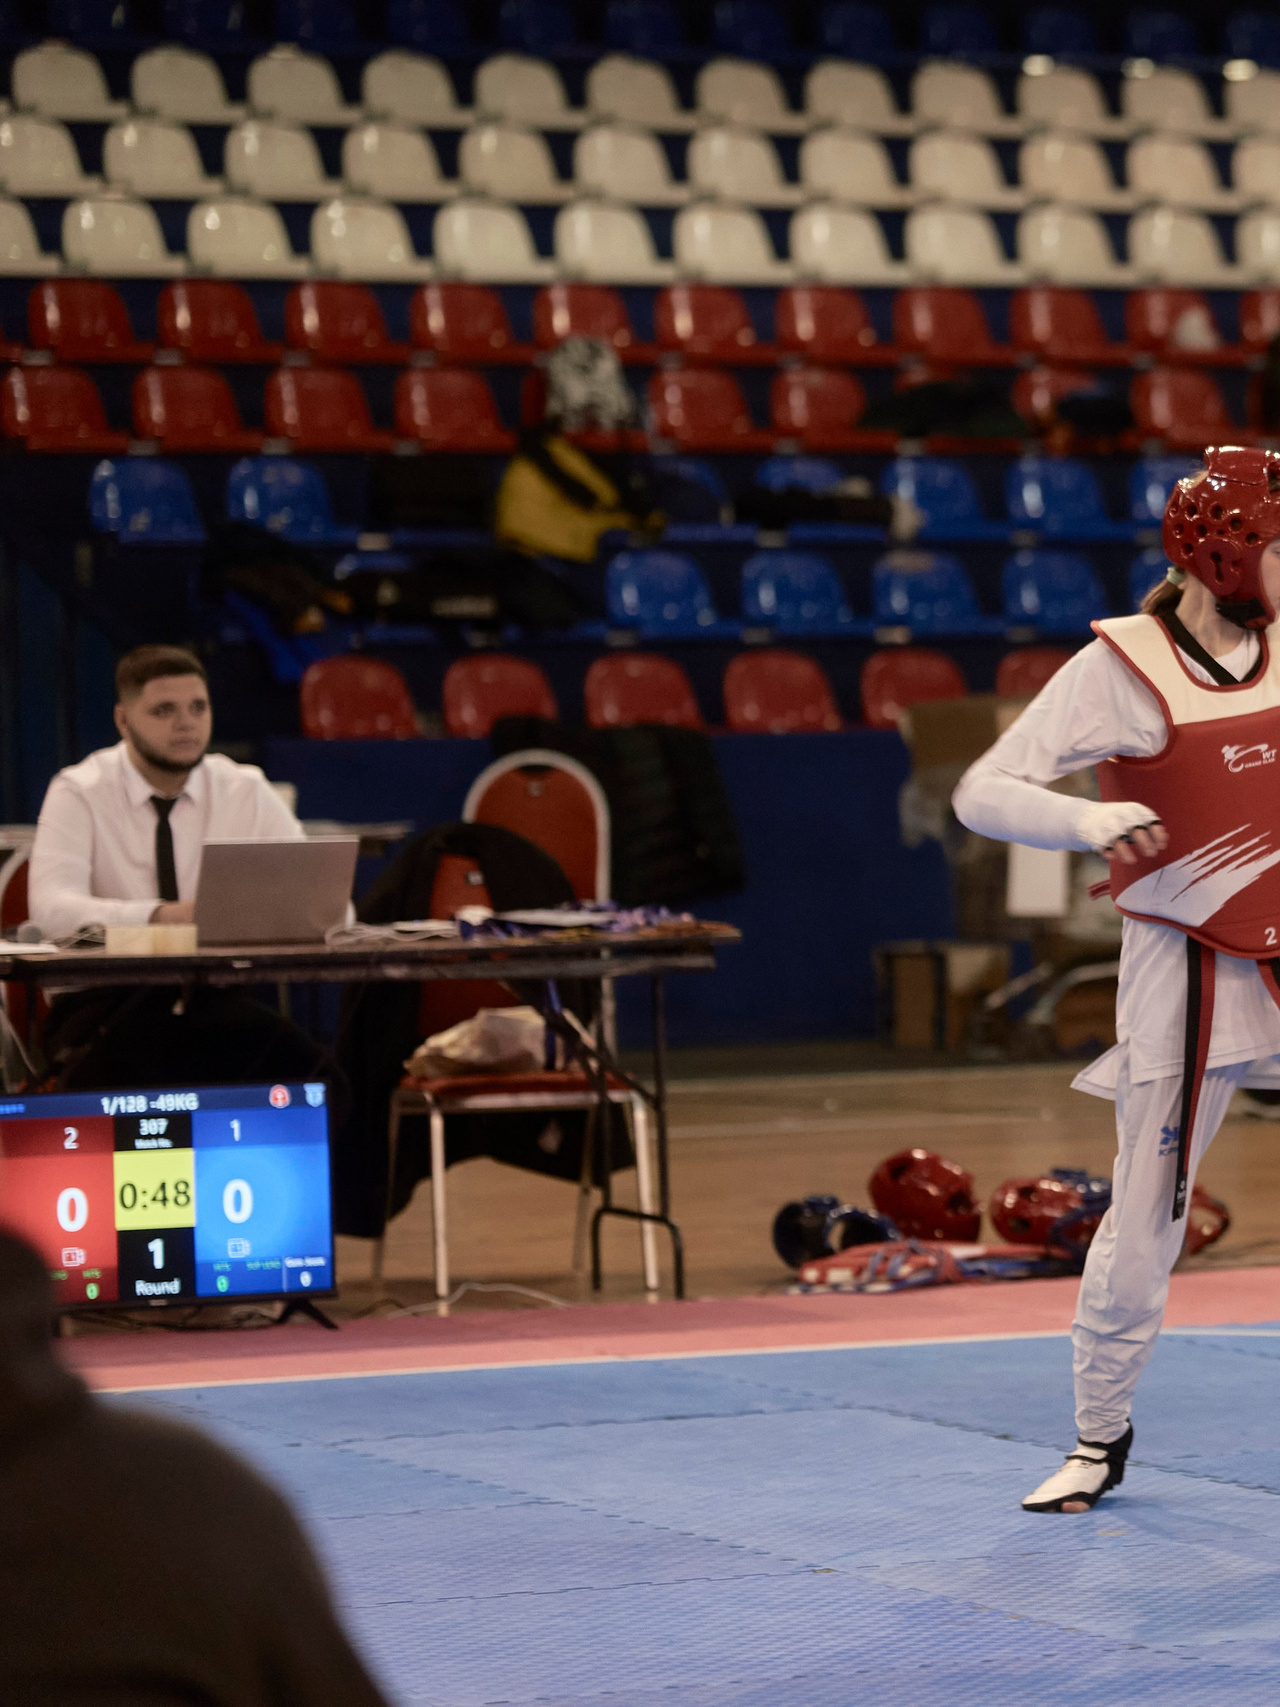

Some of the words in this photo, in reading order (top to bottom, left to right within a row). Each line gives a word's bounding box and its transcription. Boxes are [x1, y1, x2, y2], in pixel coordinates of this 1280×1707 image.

[1262, 749, 1277, 760] WT
[1264, 927, 1278, 946] 2
[101, 1095, 147, 1116] 1/128
[150, 1093, 199, 1112] -49KG
[63, 1126, 79, 1150] 2
[139, 1118, 169, 1136] 307
[230, 1119, 241, 1142] 1
[119, 1180, 191, 1210] 0:48
[222, 1179, 254, 1224] 0
[56, 1187, 89, 1233] 0
[147, 1238, 165, 1270] 1
[86, 1282, 99, 1300] 0
[135, 1278, 181, 1296] Round
